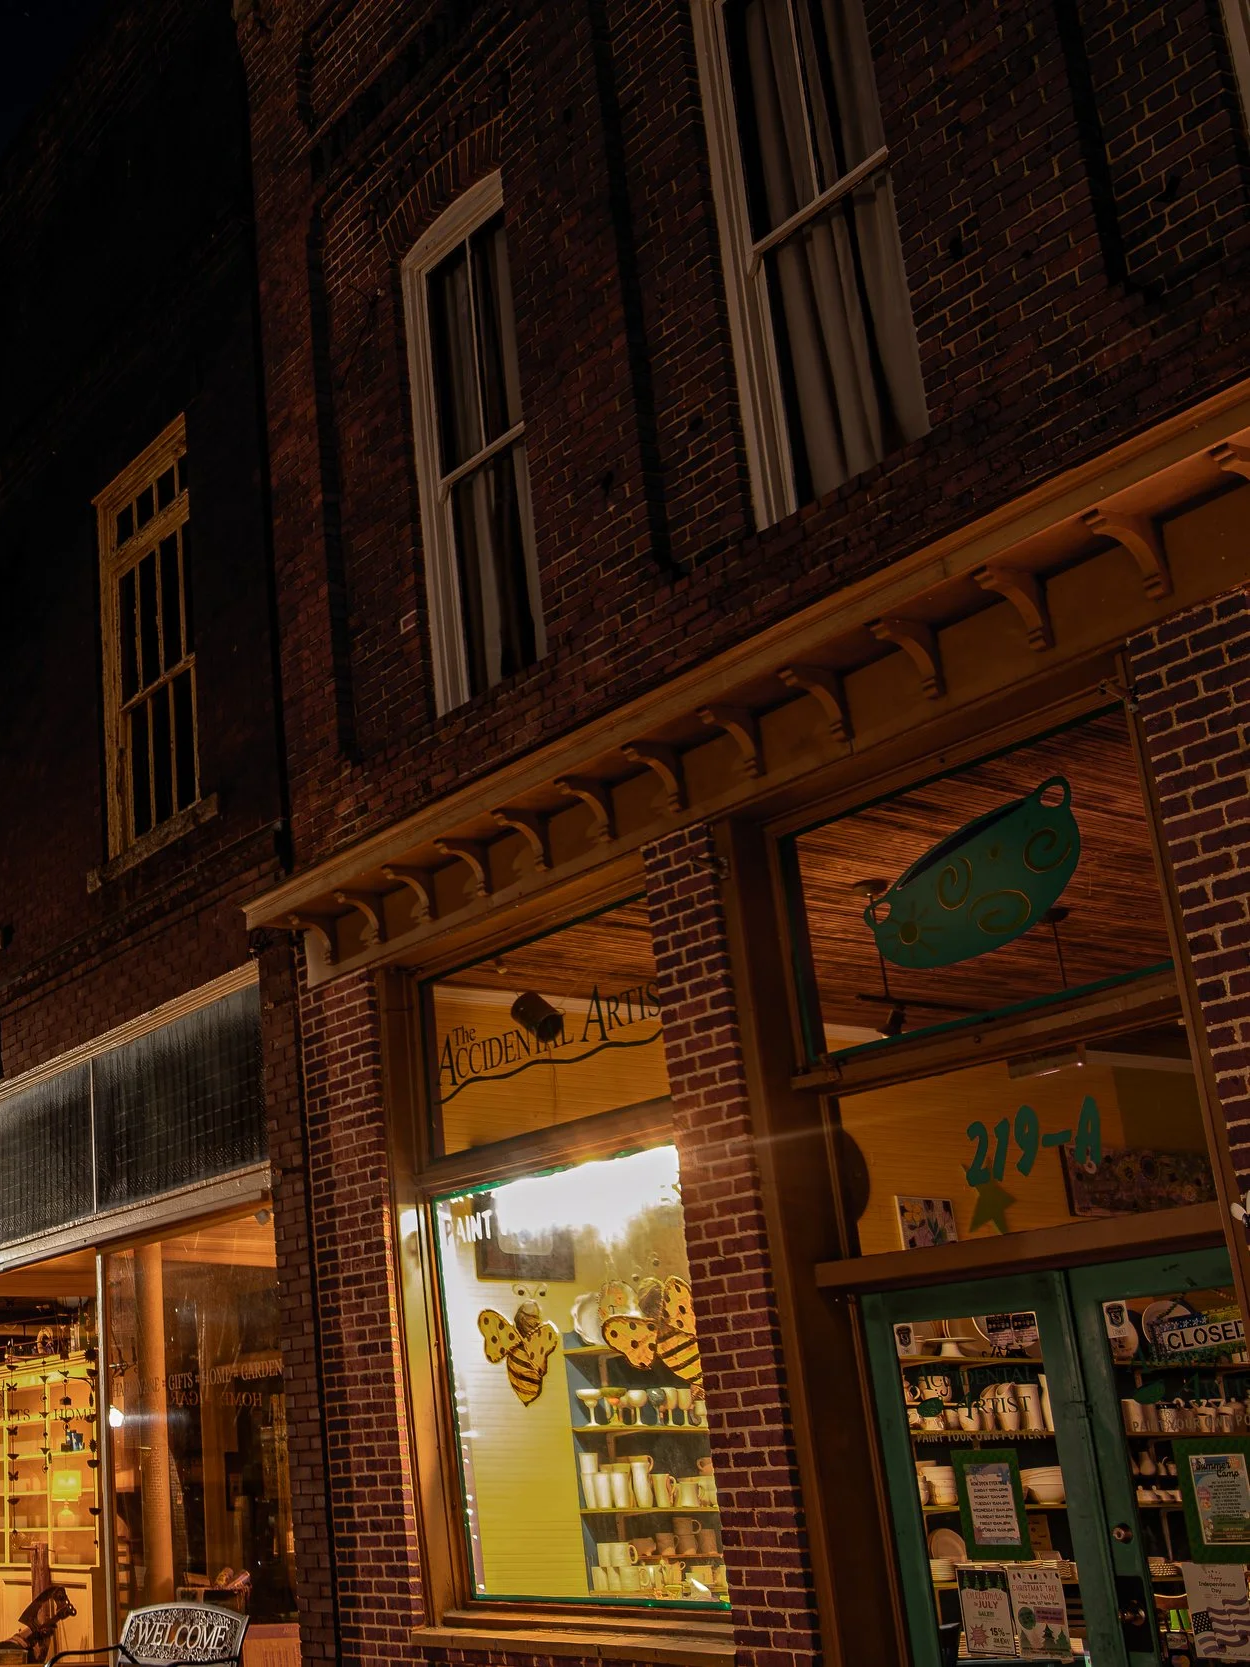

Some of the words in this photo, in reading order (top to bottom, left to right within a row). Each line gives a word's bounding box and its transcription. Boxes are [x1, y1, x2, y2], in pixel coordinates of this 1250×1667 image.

[452, 1025, 476, 1047] The
[966, 1095, 1101, 1187] 219-A
[444, 1209, 492, 1246] PAINT
[168, 1372, 193, 1390] GIFTS
[199, 1367, 231, 1386] HOME
[241, 1359, 284, 1382] GARDEN
[956, 1392, 1032, 1420] ARTIST
[1196, 1460, 1231, 1471] Summer
[1217, 1470, 1240, 1479] Camp
[979, 1600, 998, 1609] JULY
[136, 1622, 229, 1650] WELCOME
